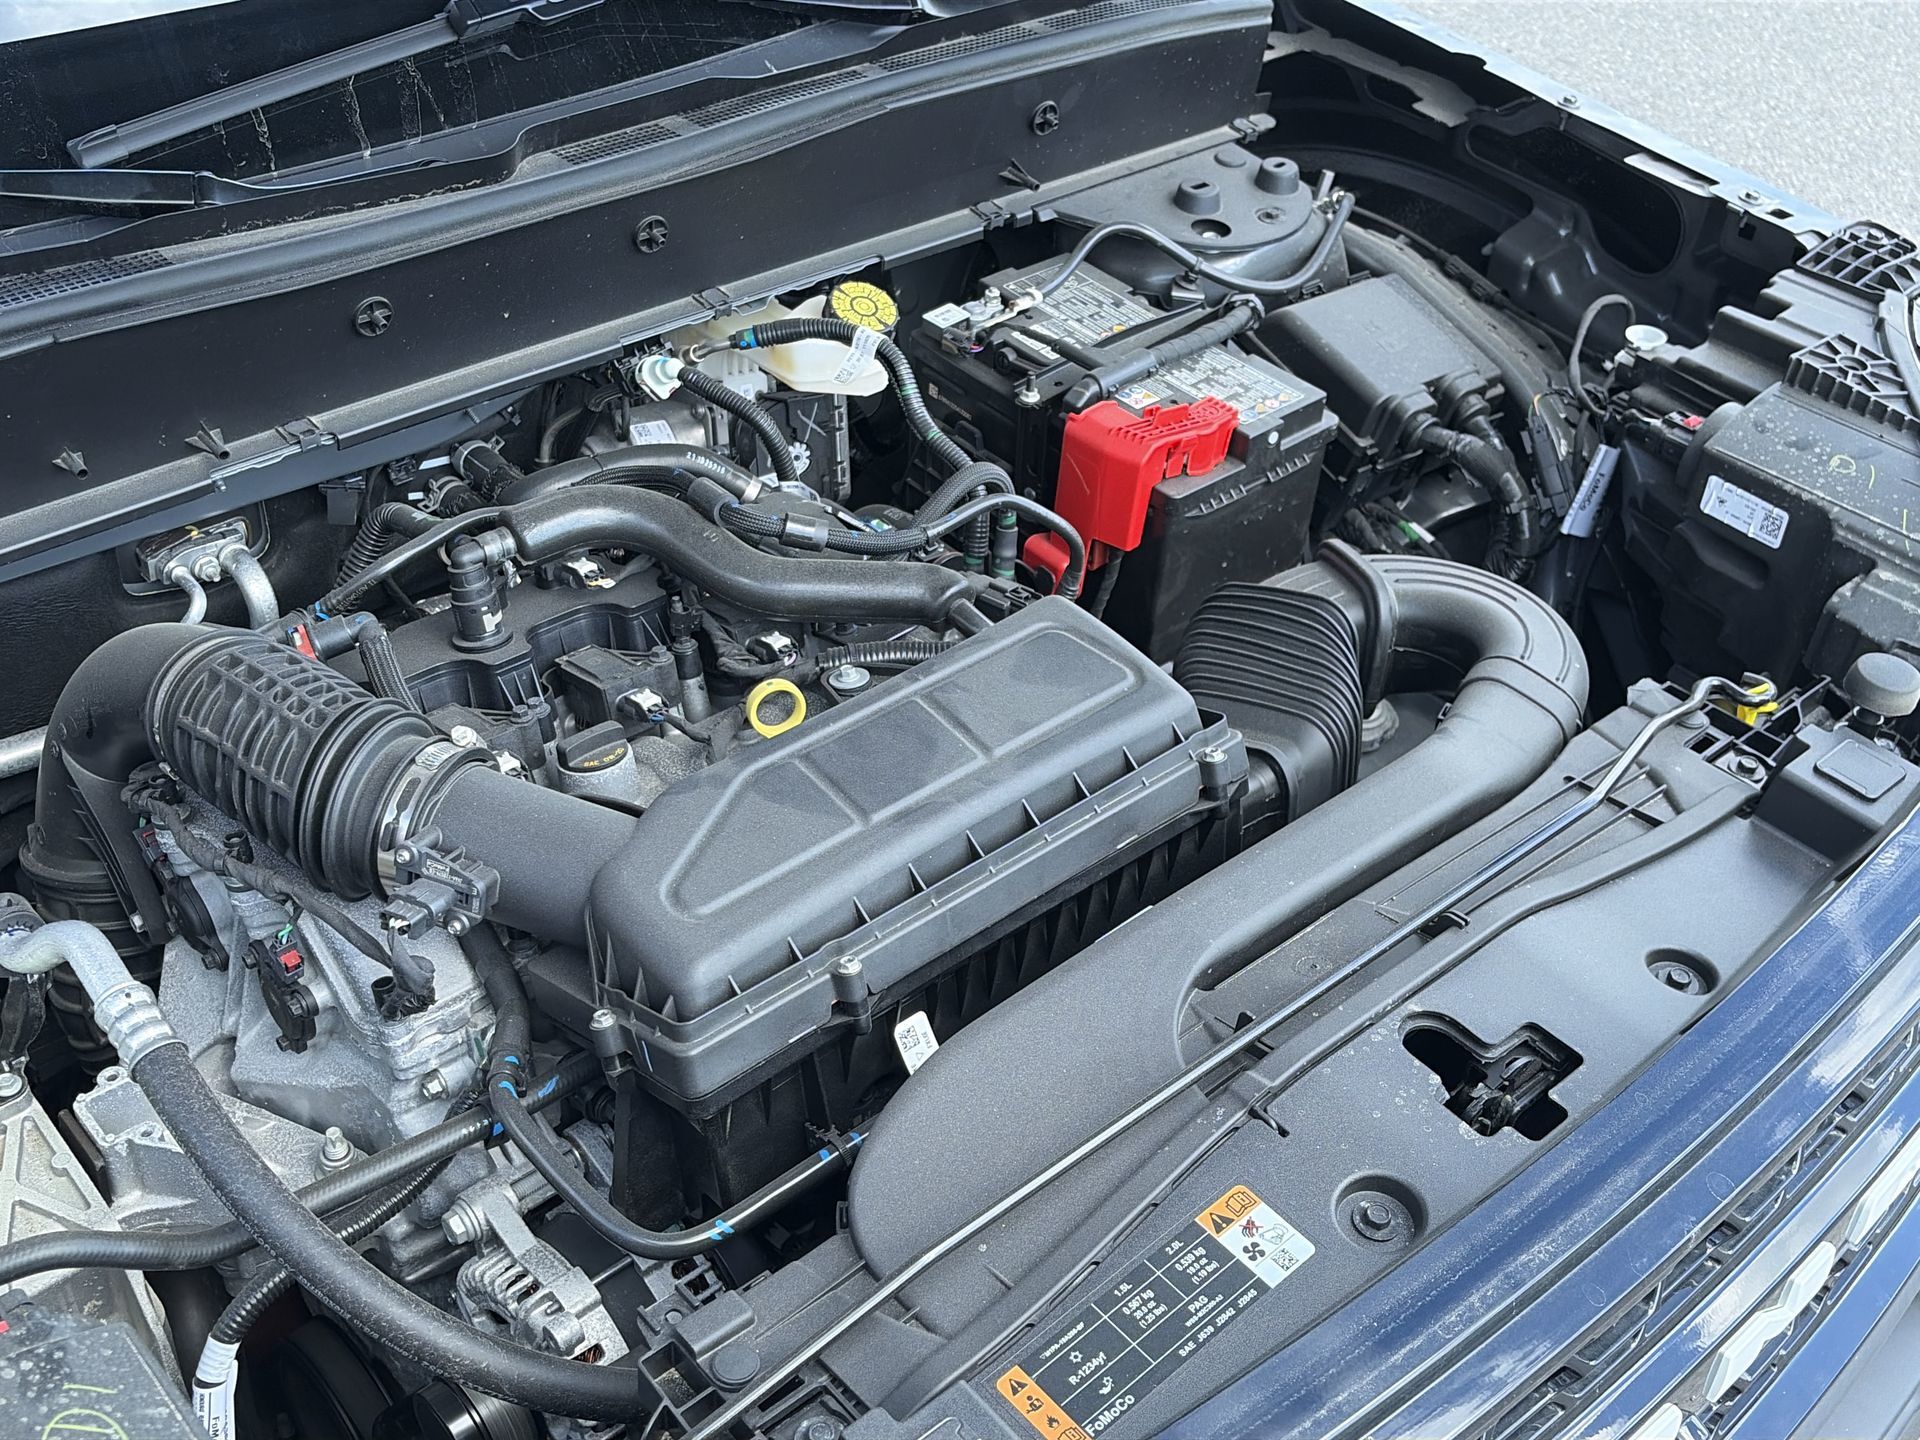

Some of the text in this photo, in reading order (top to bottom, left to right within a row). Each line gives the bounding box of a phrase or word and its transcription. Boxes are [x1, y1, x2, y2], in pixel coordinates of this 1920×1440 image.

[238, 1217, 277, 1257] SUCTION
[1165, 1240, 1184, 1255] 2.0L
[1174, 1247, 1207, 1271] 0.539 kg
[1199, 1257, 1209, 1266] oz
[1114, 1282, 1133, 1297] 1.5L
[1122, 1289, 1155, 1315] 0.567 kg
[1133, 1300, 1157, 1320] 20.0 oz
[1187, 1295, 1208, 1313] PAG
[1139, 1314, 1156, 1329] (1.25
[1178, 1288, 1258, 1357] SAE J639 J2842 J2845
[1068, 1351, 1107, 1386] R-1234yf
[211, 1416, 220, 1440] FoM
[1085, 1395, 1135, 1437] FoMoCo
